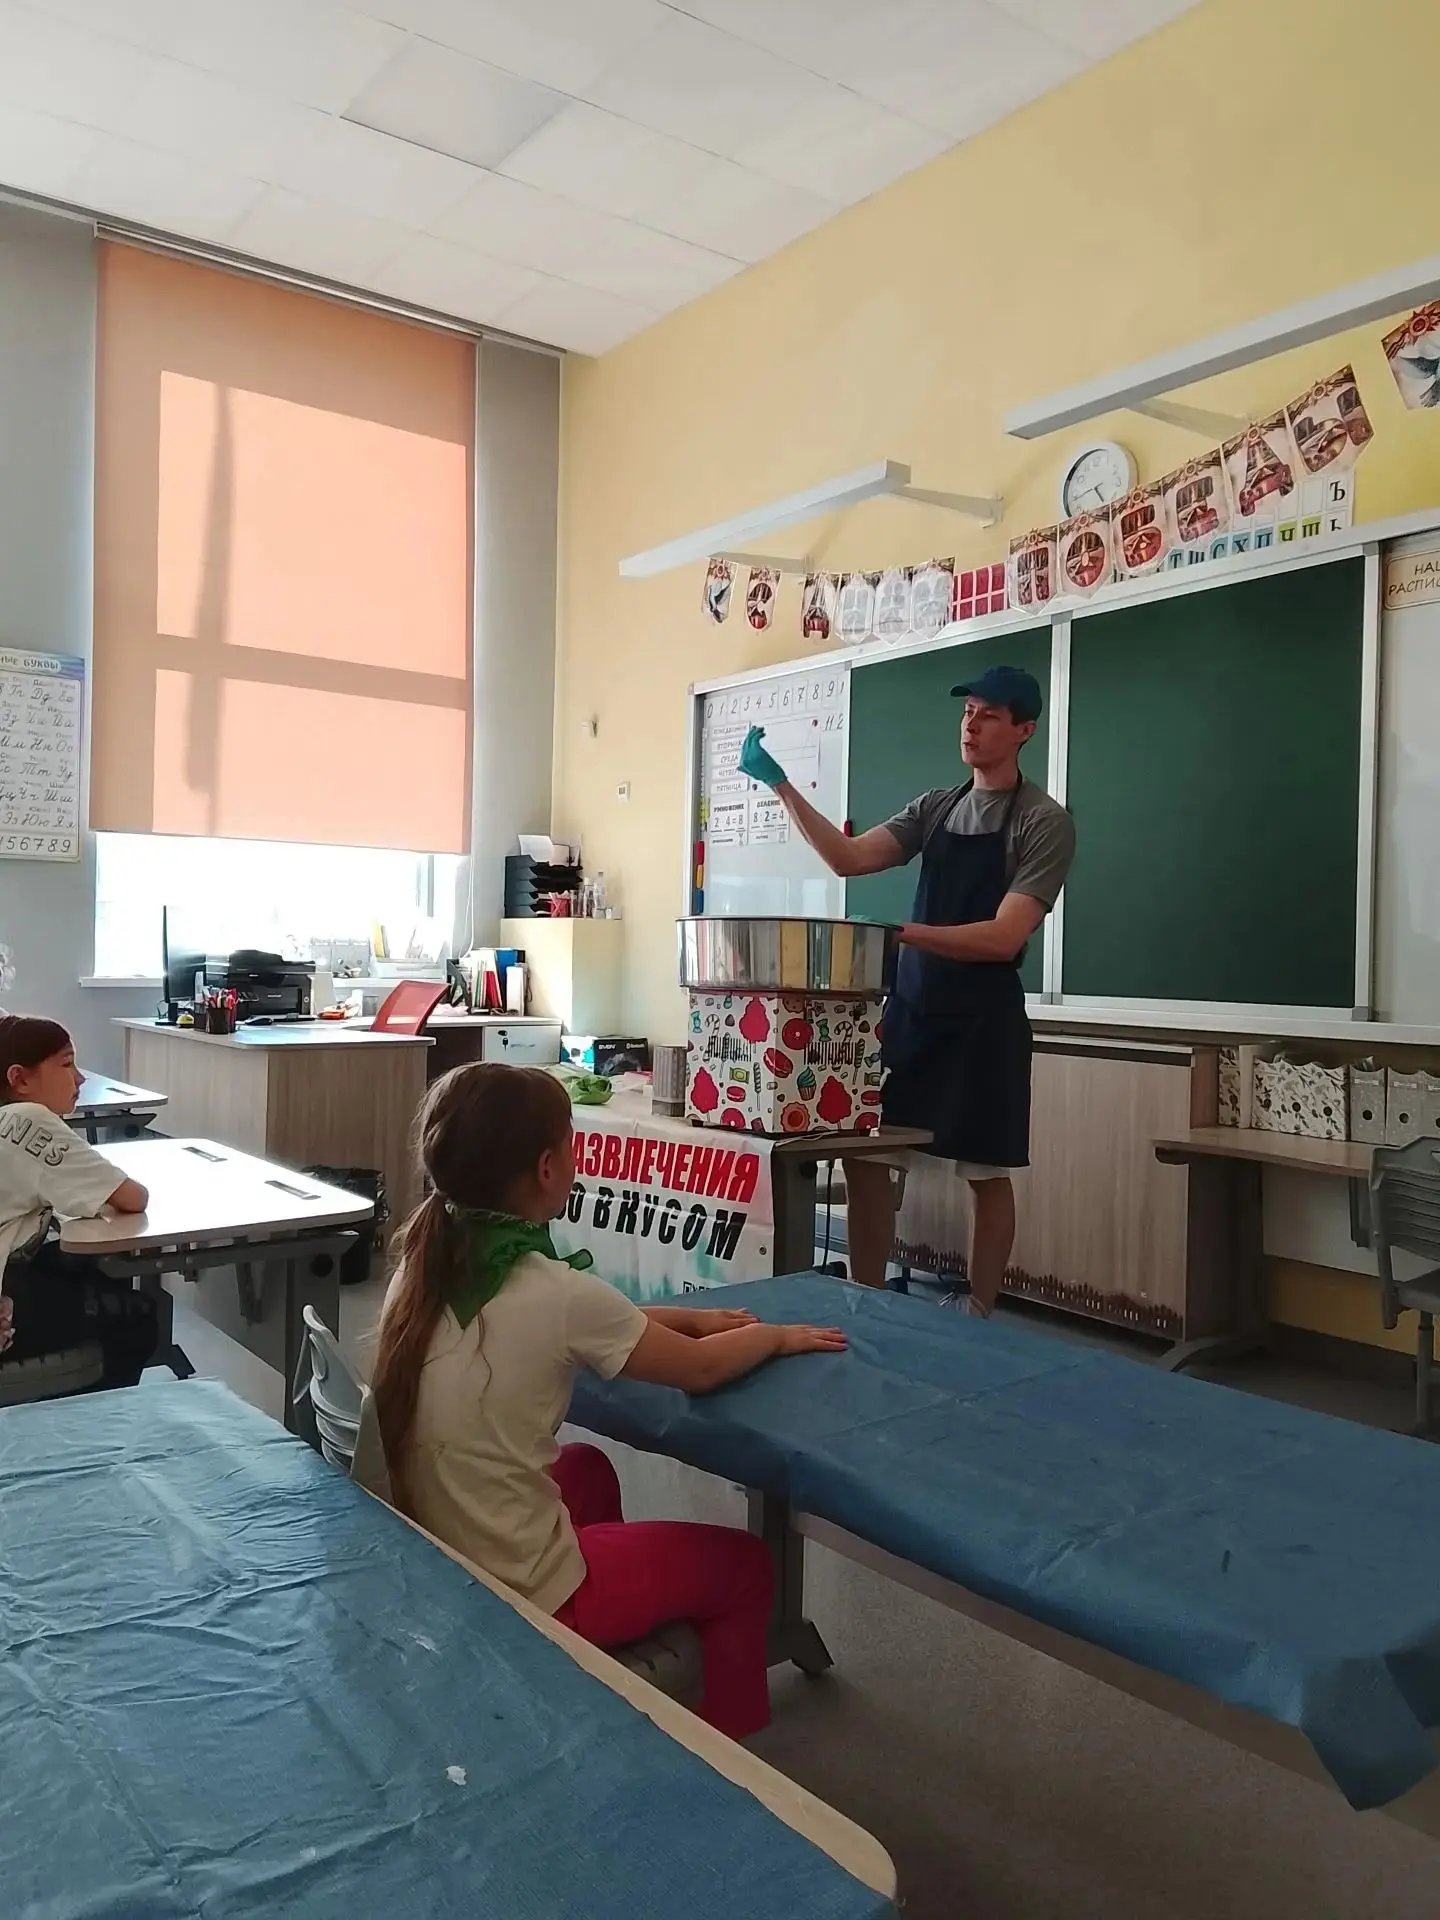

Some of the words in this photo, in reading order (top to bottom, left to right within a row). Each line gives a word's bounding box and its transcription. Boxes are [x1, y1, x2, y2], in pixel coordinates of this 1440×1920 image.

[1017, 387, 1374, 606] ПОБЕДЫ
[23, 659, 59, 670] БУКВЫ
[572, 1131, 760, 1204] АЗВЛЕЧЕНИЯ
[592, 1185, 748, 1261] ВКУСОМ
